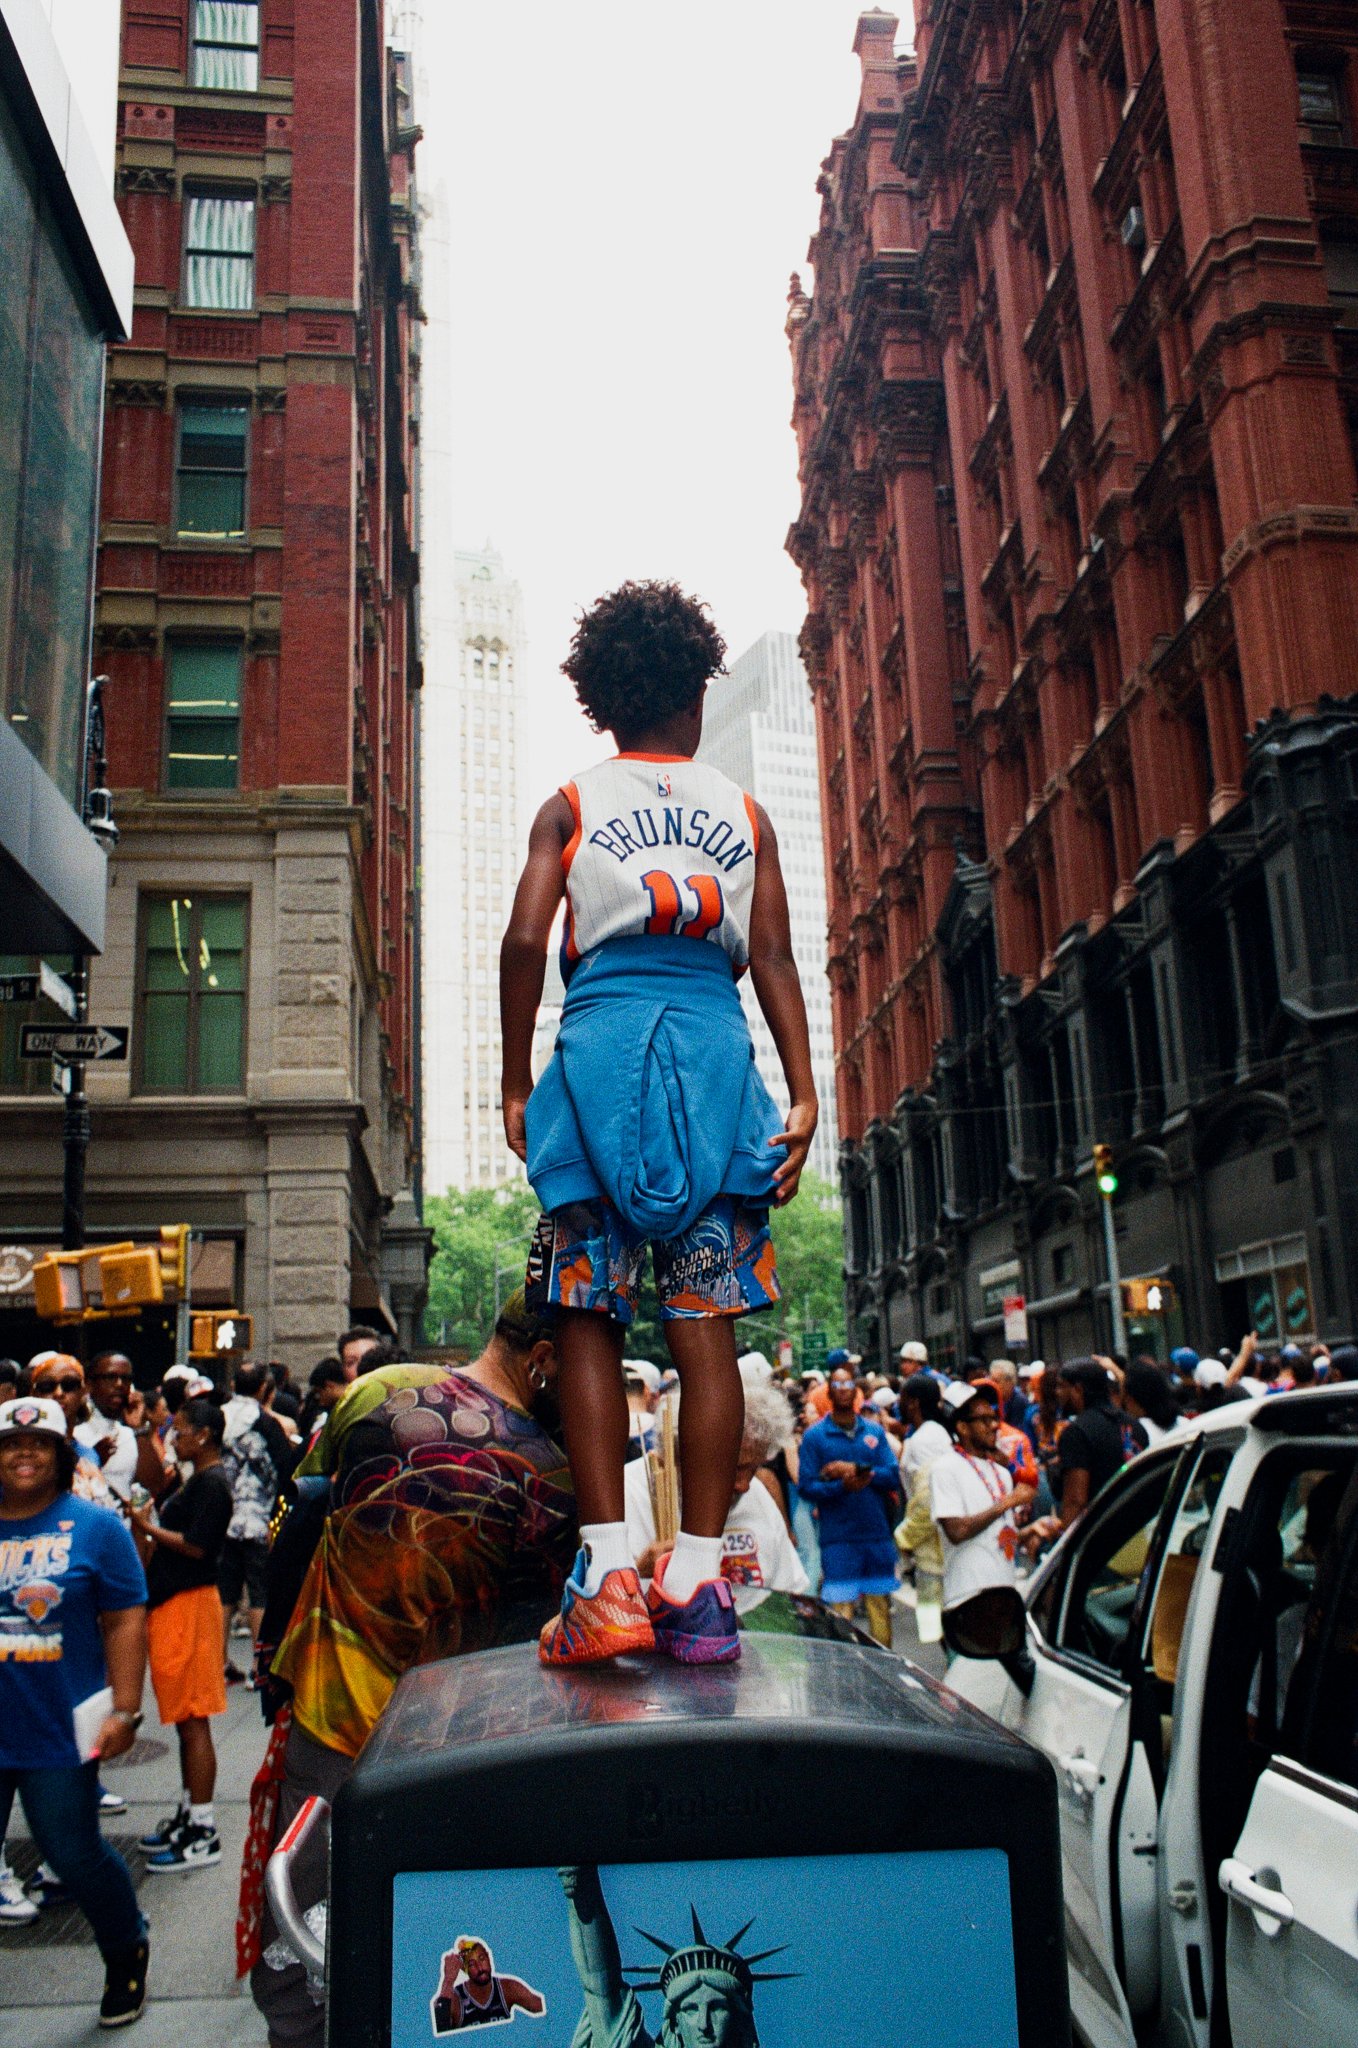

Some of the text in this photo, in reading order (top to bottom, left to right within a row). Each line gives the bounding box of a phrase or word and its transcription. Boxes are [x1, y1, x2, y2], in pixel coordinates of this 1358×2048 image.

[589, 807, 753, 872] BRUNSON
[640, 869, 724, 939] 11
[75, 1033, 107, 1050] WAY
